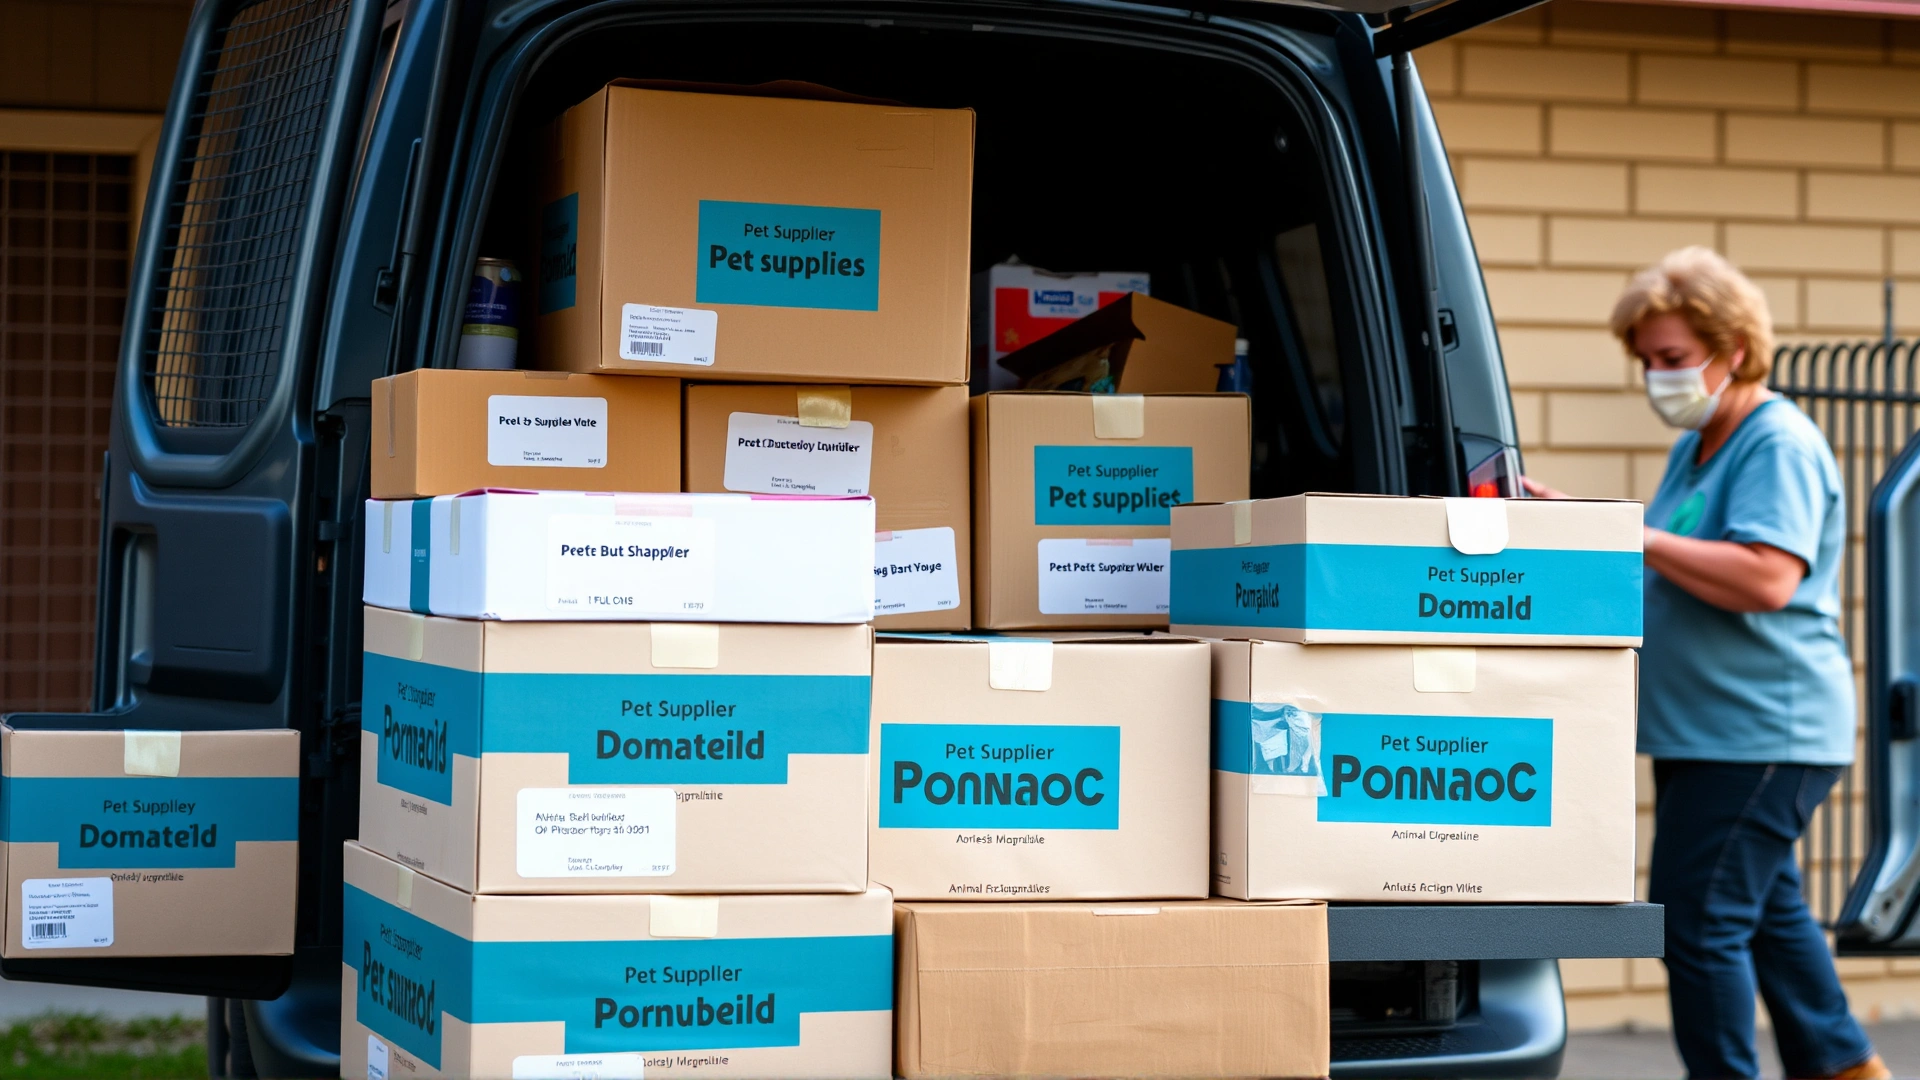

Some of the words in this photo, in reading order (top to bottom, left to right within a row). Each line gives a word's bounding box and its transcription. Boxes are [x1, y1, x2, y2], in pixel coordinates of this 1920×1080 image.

[744, 223, 769, 238] Pet
[710, 244, 755, 272] Pet
[760, 251, 865, 280] supplies
[1068, 464, 1092, 477] Pet
[1049, 485, 1087, 508] Pet
[1093, 487, 1181, 514] supplies
[600, 545, 624, 557] But
[1428, 566, 1456, 582] Pet
[622, 699, 653, 717] Pet
[658, 699, 736, 721] Supplier
[596, 729, 765, 761] Domateild
[946, 743, 975, 759] Pet
[981, 744, 1055, 763] Supplier
[1381, 734, 1410, 752] Pet
[1416, 735, 1489, 756] Supplier
[103, 799, 128, 814] Pet
[625, 966, 657, 984] Pet
[594, 992, 775, 1029] Pornubeild
